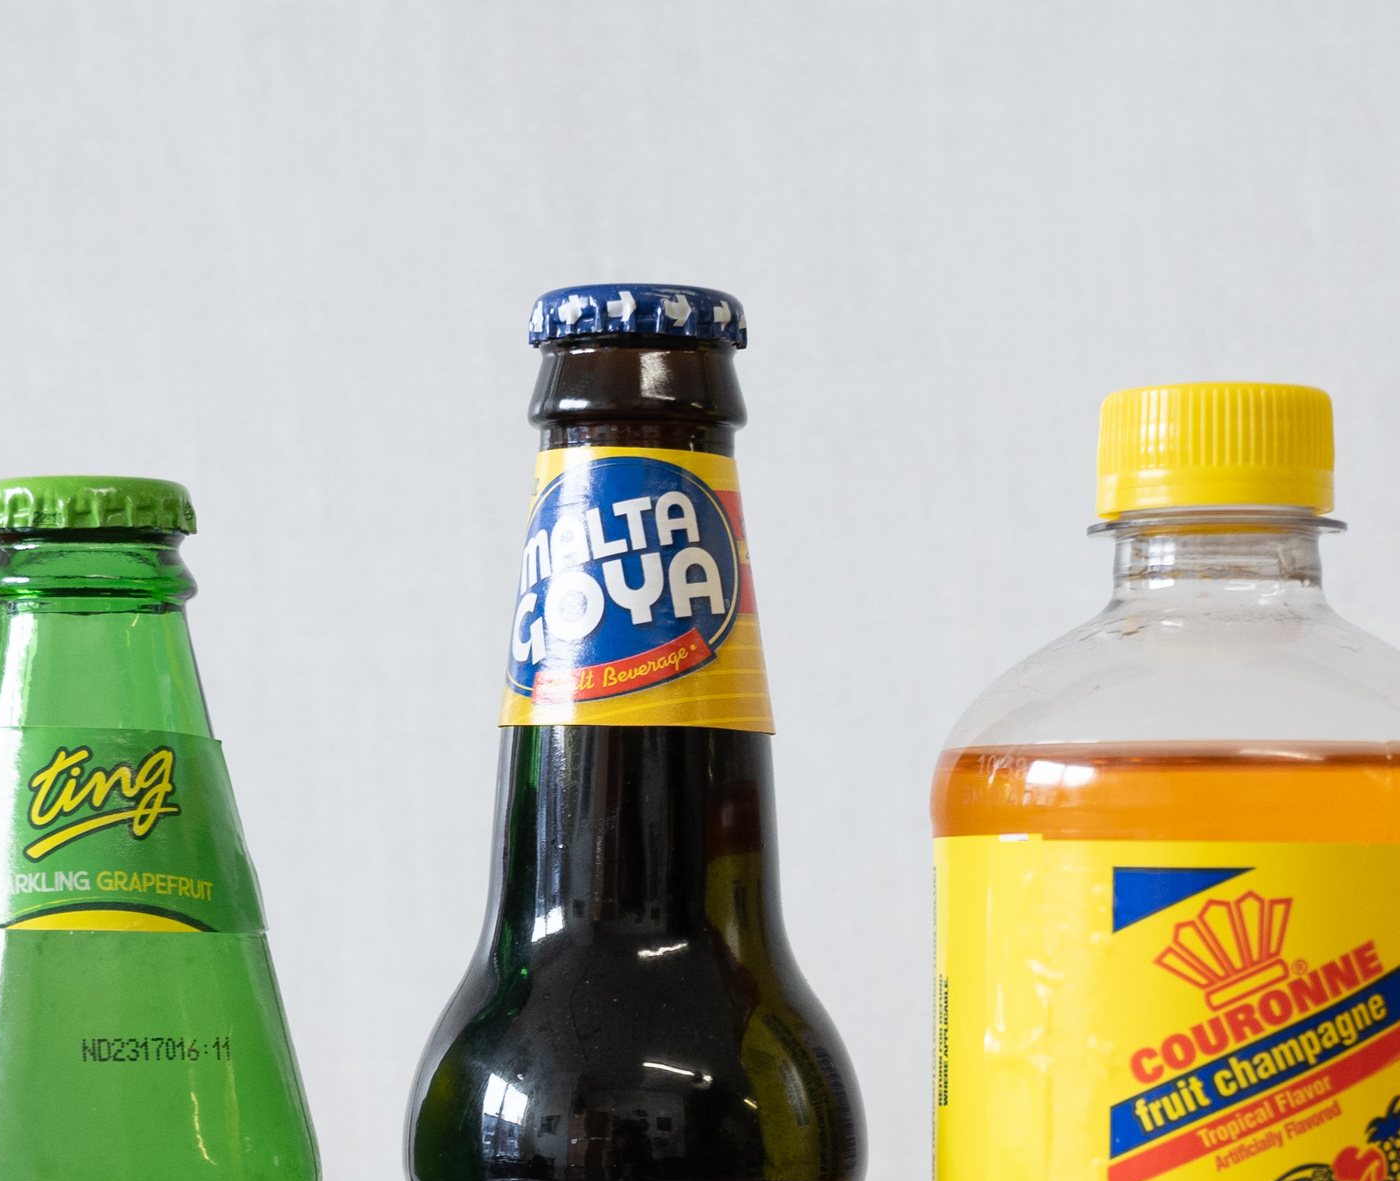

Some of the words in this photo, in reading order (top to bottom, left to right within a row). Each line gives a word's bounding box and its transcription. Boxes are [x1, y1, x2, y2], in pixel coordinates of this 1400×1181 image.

[520, 491, 700, 595] MALTA
[512, 547, 726, 665] GOYA
[603, 647, 689, 688] Beverage
[28, 746, 180, 841] ting
[96, 870, 214, 901] GRAPEFRUIT
[1129, 939, 1385, 1085] COURONNE
[1134, 1074, 1212, 1134] fruit
[1212, 991, 1389, 1098] champagne
[1197, 1096, 1274, 1150] Tropical
[1275, 1074, 1334, 1114] Flavor
[1214, 1129, 1285, 1173] Artificially
[1283, 1099, 1343, 1140] Flavored
